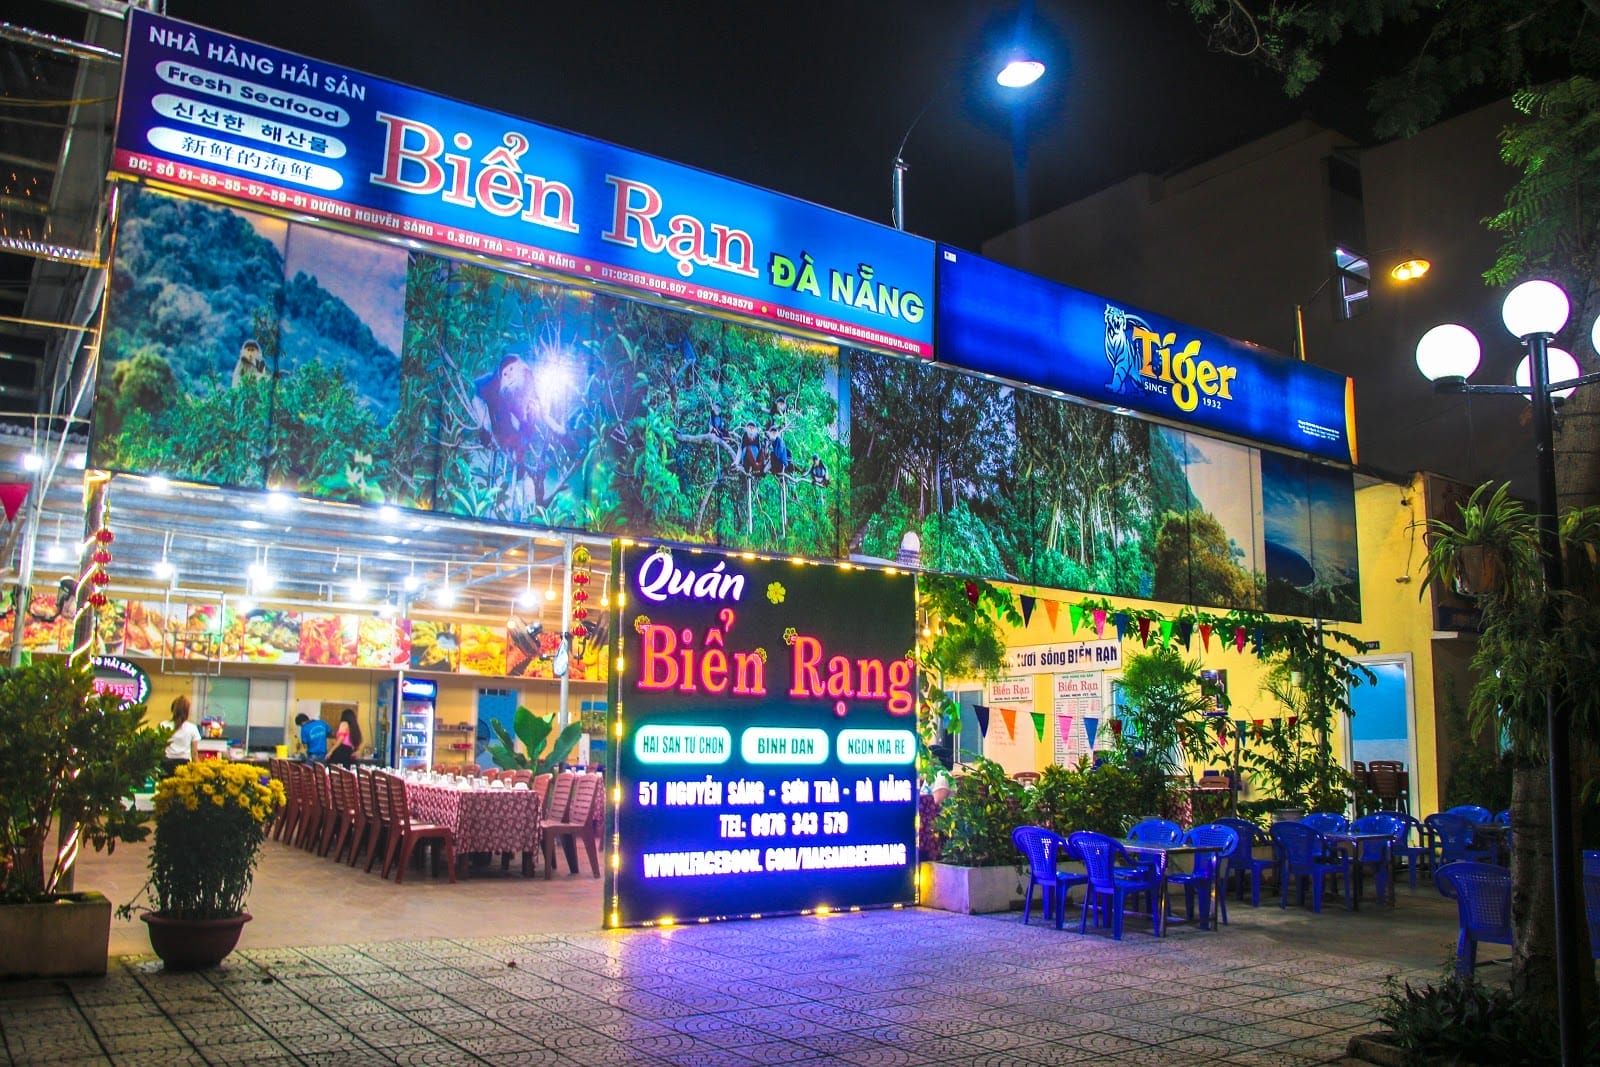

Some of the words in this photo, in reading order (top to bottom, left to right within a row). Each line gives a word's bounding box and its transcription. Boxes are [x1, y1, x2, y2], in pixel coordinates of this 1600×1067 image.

[150, 26, 200, 56] NHÀ
[207, 43, 274, 75] HÀNG
[281, 63, 318, 89] HẢI
[324, 75, 366, 101] SẢN
[168, 66, 231, 94] Fresh
[239, 85, 340, 123] Seafood
[172, 102, 245, 131] 신선한
[261, 124, 329, 154] 해산물
[370, 110, 579, 233] Biển
[601, 174, 759, 277] Rạn
[355, 210, 400, 228] NGUYỄN
[403, 218, 433, 236] SÁNG
[483, 238, 503, 251] TRÀ
[770, 250, 821, 297] ĐÀ
[830, 262, 924, 324] NẴNG
[776, 308, 813, 325] Website:
[1132, 327, 1238, 413] Tiger
[1143, 381, 1168, 396] SINCE
[1201, 397, 1222, 410] 1932
[638, 552, 745, 601] Quán
[637, 608, 767, 694] Biển
[789, 635, 914, 717] Rạng
[1096, 646, 1117, 664] RẠN
[638, 781, 658, 805] 51
[792, 811, 818, 835] 343
[823, 811, 849, 834] 579
